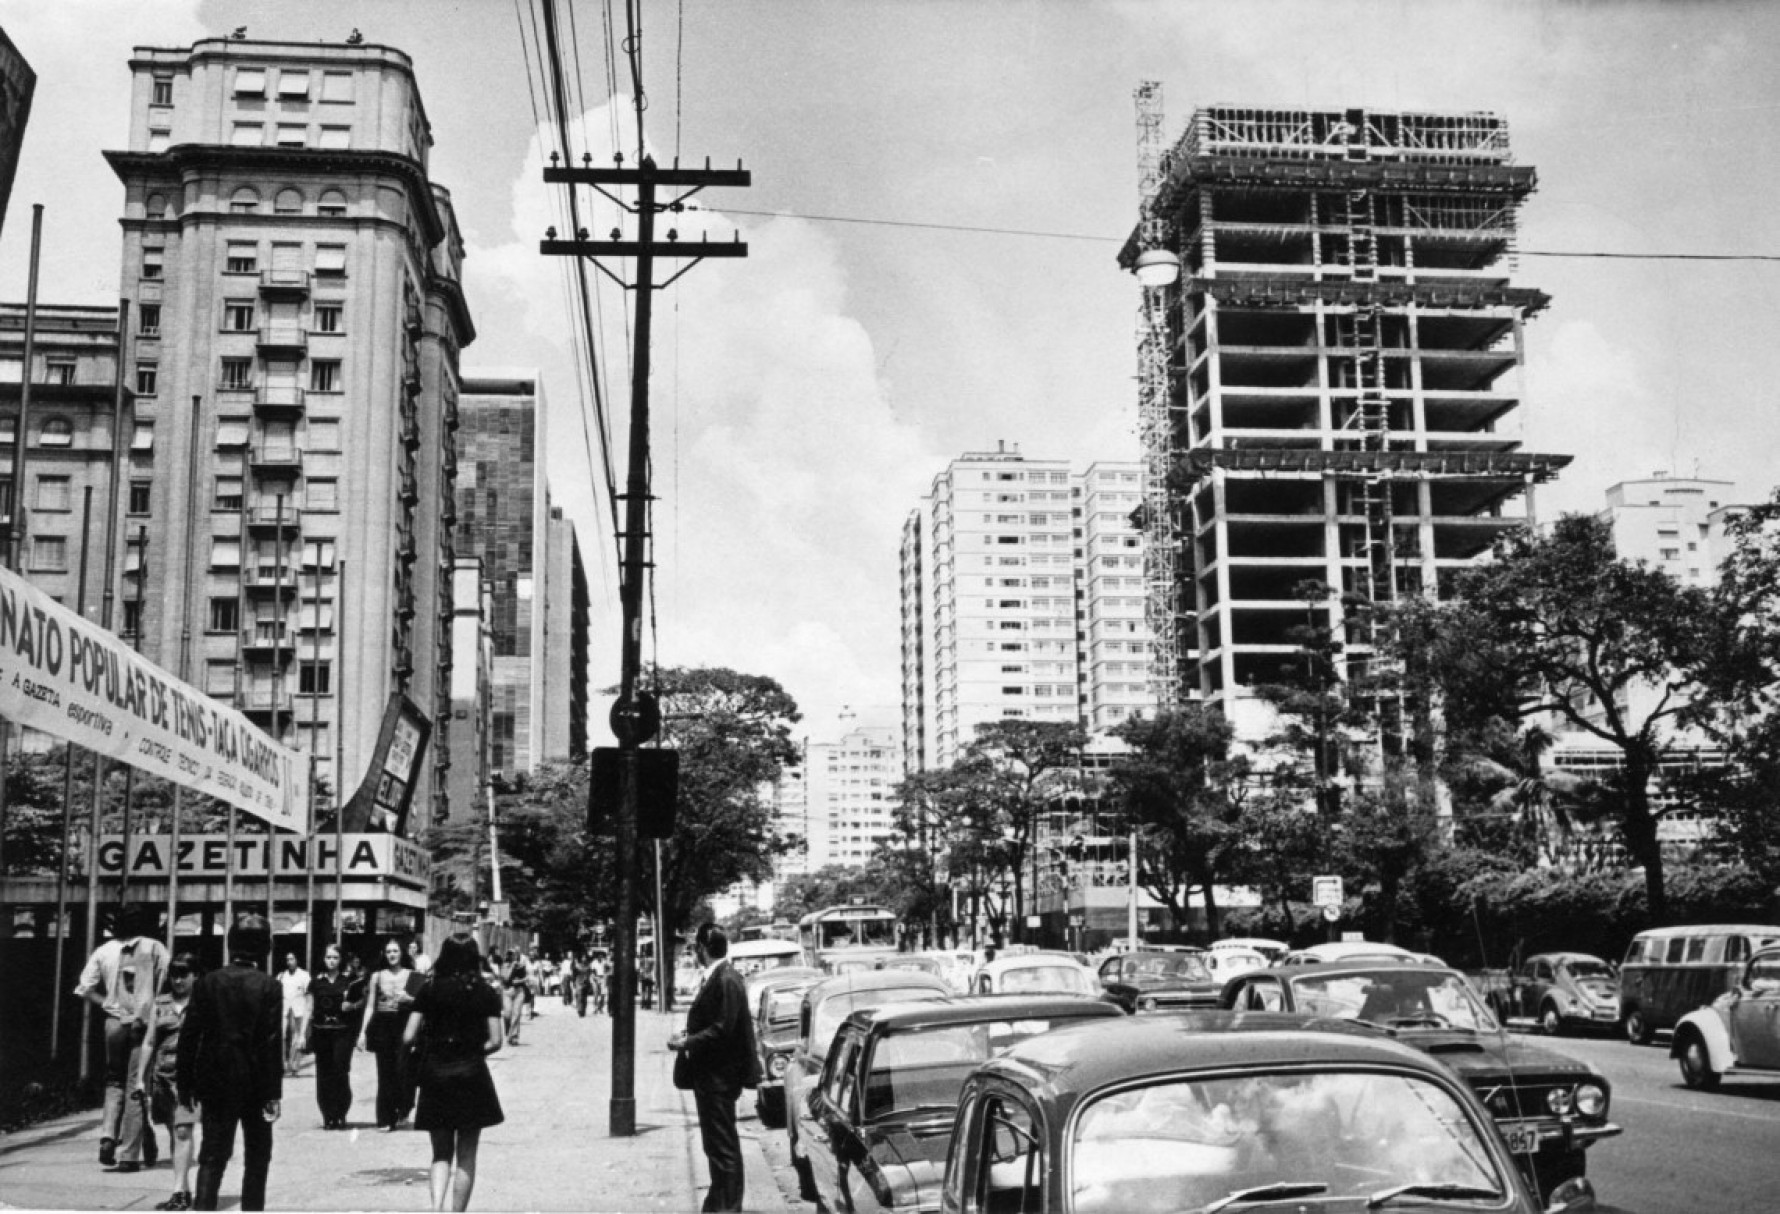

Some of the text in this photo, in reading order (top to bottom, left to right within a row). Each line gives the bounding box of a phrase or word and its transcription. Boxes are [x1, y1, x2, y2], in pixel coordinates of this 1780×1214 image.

[0, 583, 62, 677] NATO
[69, 626, 147, 720] POPULAR
[150, 676, 169, 731] DE
[11, 671, 20, 689] A
[22, 678, 60, 707] GAZETA
[67, 702, 113, 736] esportiva
[98, 840, 379, 871] GAZETINHA
